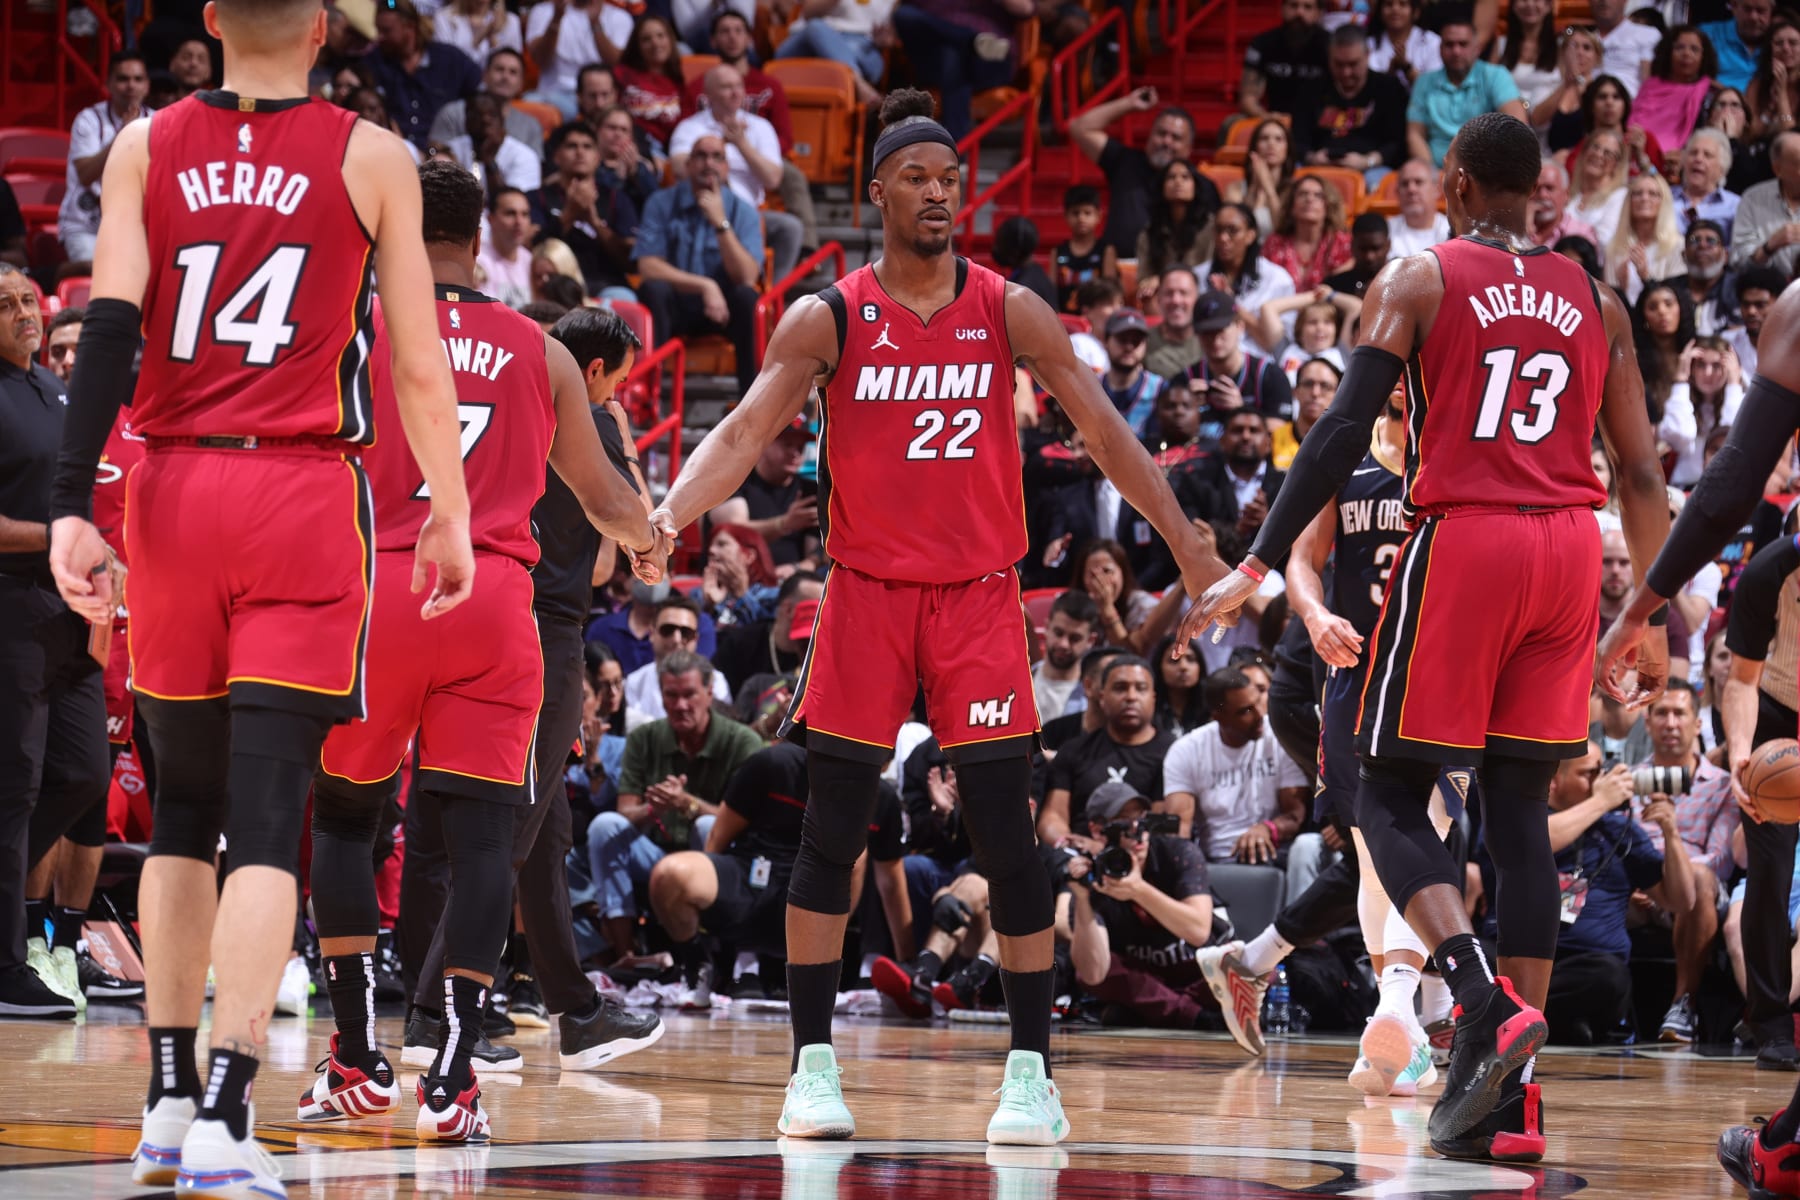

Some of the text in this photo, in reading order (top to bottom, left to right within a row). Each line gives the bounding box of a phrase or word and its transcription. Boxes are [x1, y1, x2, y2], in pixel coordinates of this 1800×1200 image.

[177, 161, 310, 216] HERRO
[170, 243, 308, 366] 14
[863, 305, 877, 321] 6
[1468, 283, 1583, 337] ADEBAYO
[955, 328, 987, 341] UKG
[438, 337, 514, 381] WRY
[853, 362, 994, 402] MIAMI
[1472, 347, 1571, 444] 13
[905, 409, 983, 460] 22
[1339, 499, 1375, 535] NEW
